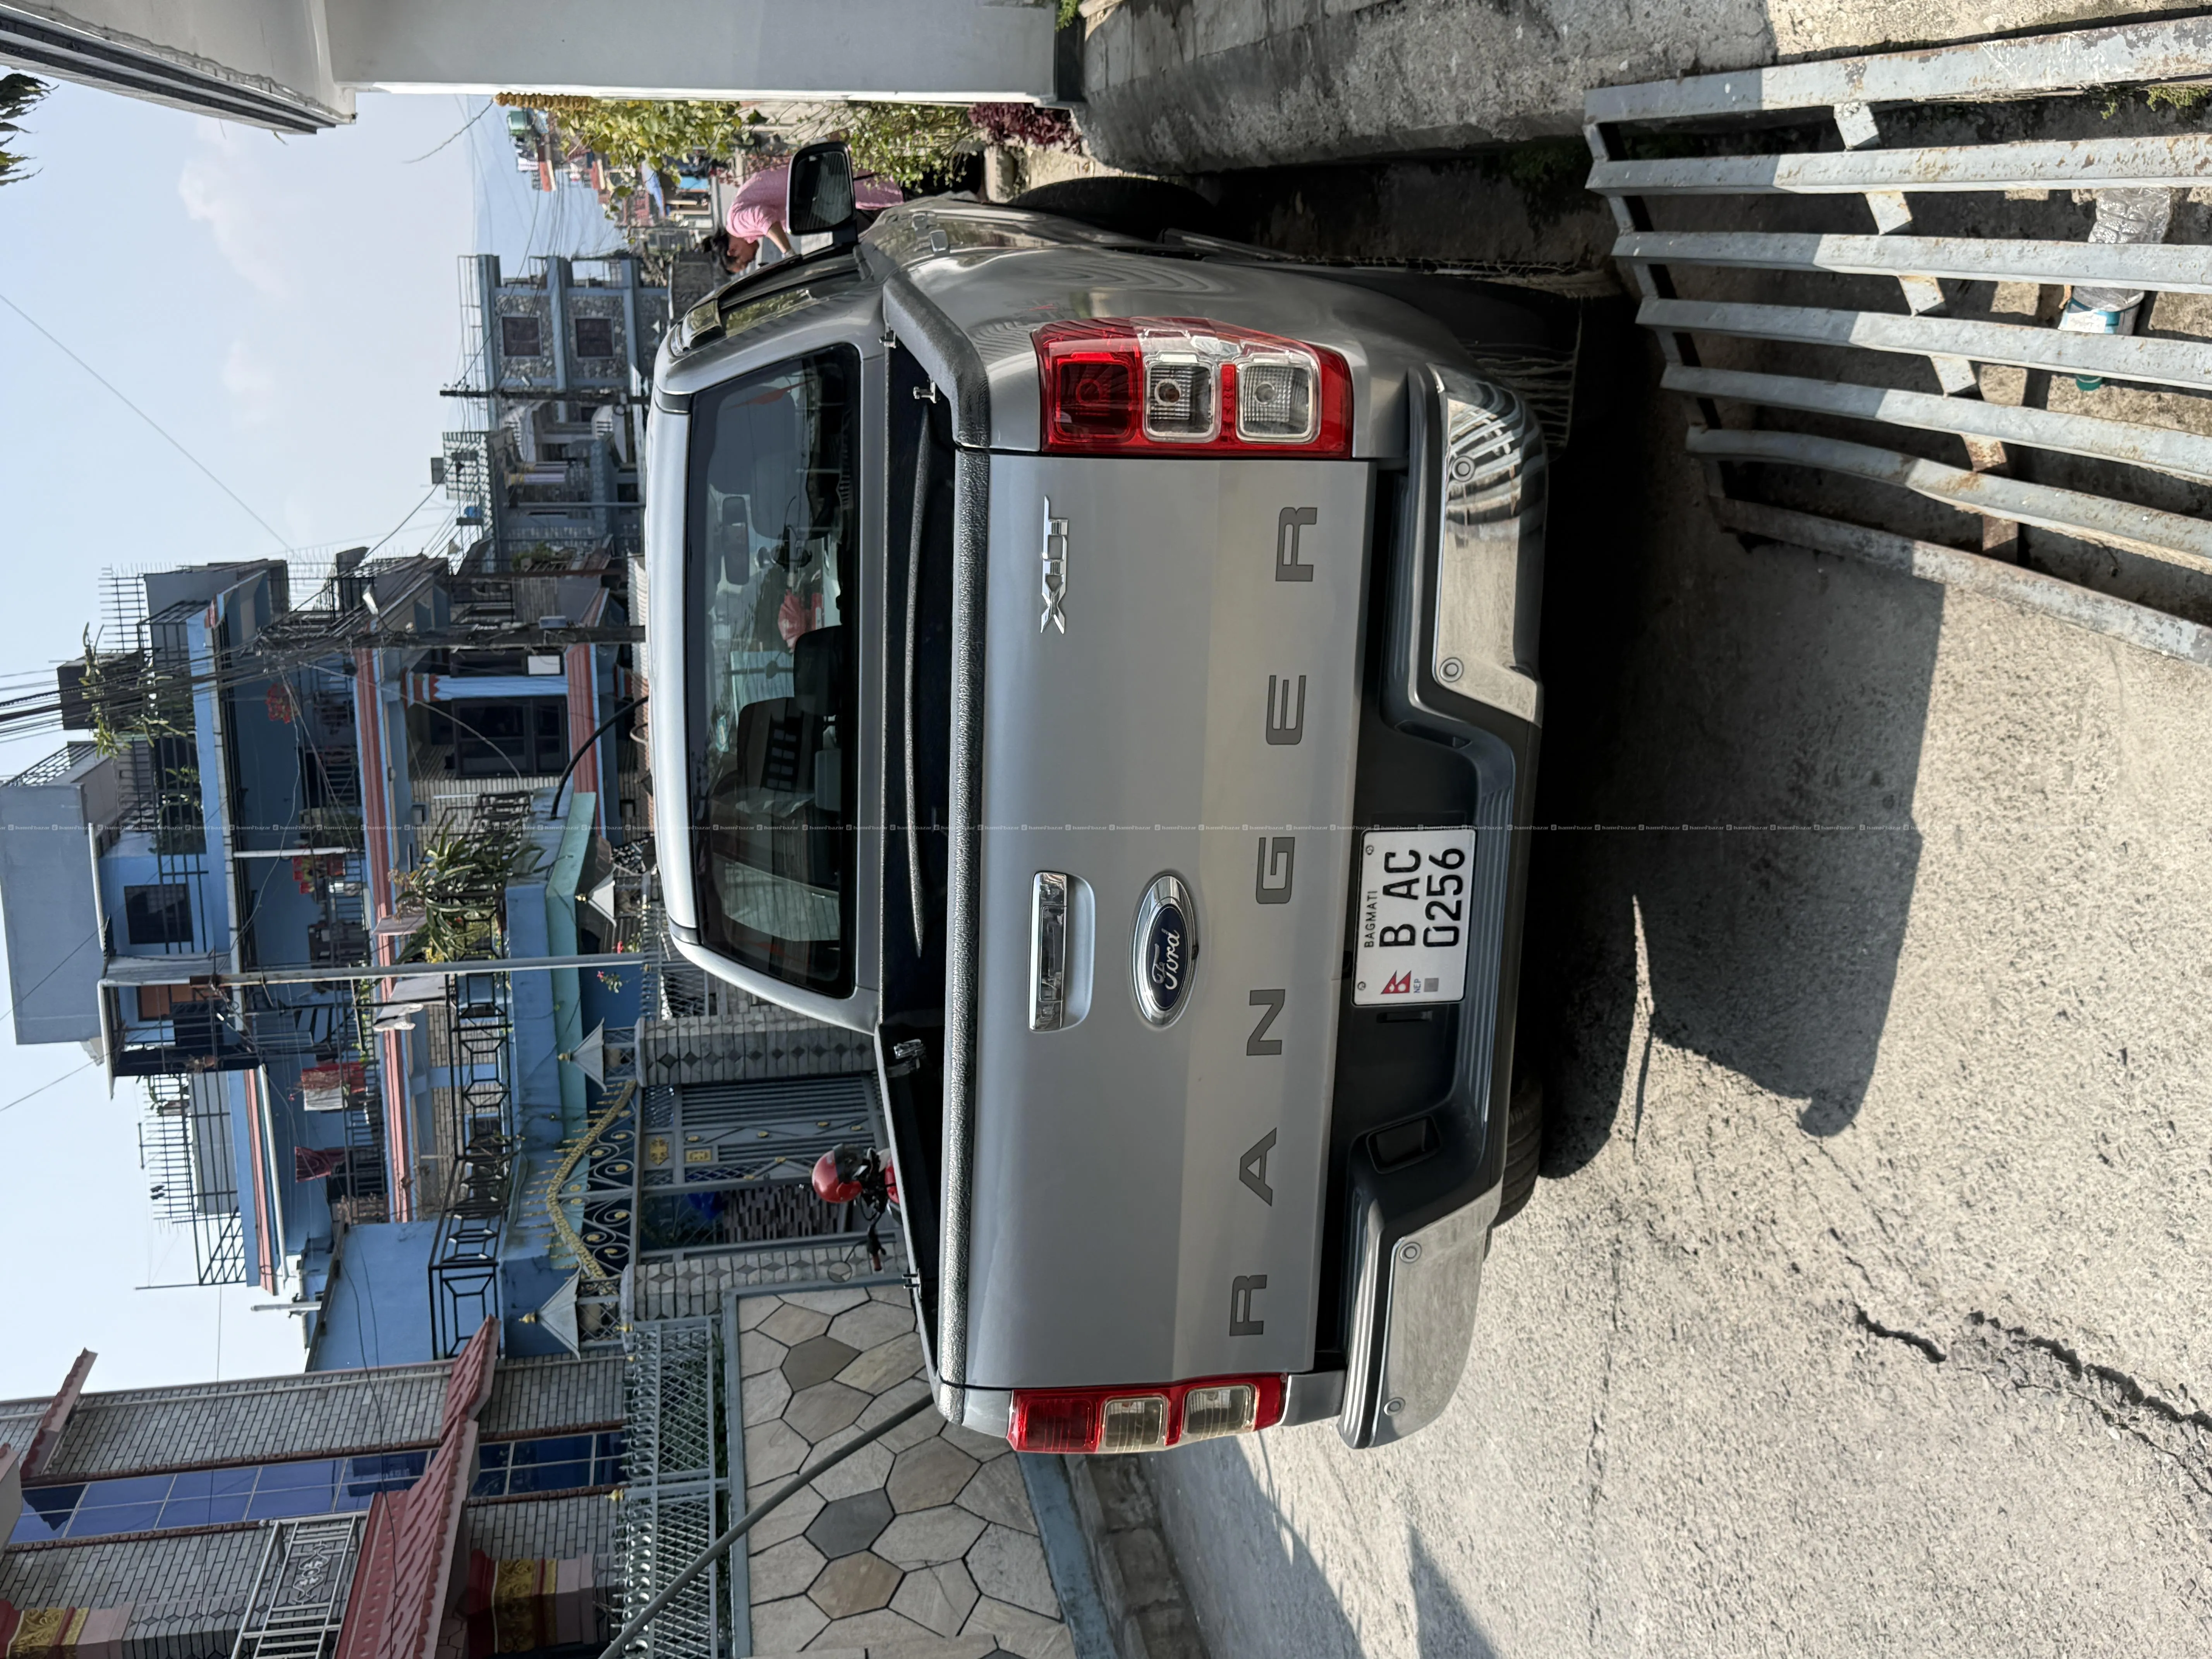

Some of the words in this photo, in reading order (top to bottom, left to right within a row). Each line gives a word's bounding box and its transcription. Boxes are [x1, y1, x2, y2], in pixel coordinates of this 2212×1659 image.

[1040, 495, 1068, 634] XLT
[1382, 849, 1421, 900] AC
[1423, 848, 1465, 947] 0256
[1229, 507, 1317, 1337] RANGER
[1364, 890, 1378, 948] BAGMATI
[1379, 923, 1415, 947] B
[1151, 927, 1180, 990] Ford
